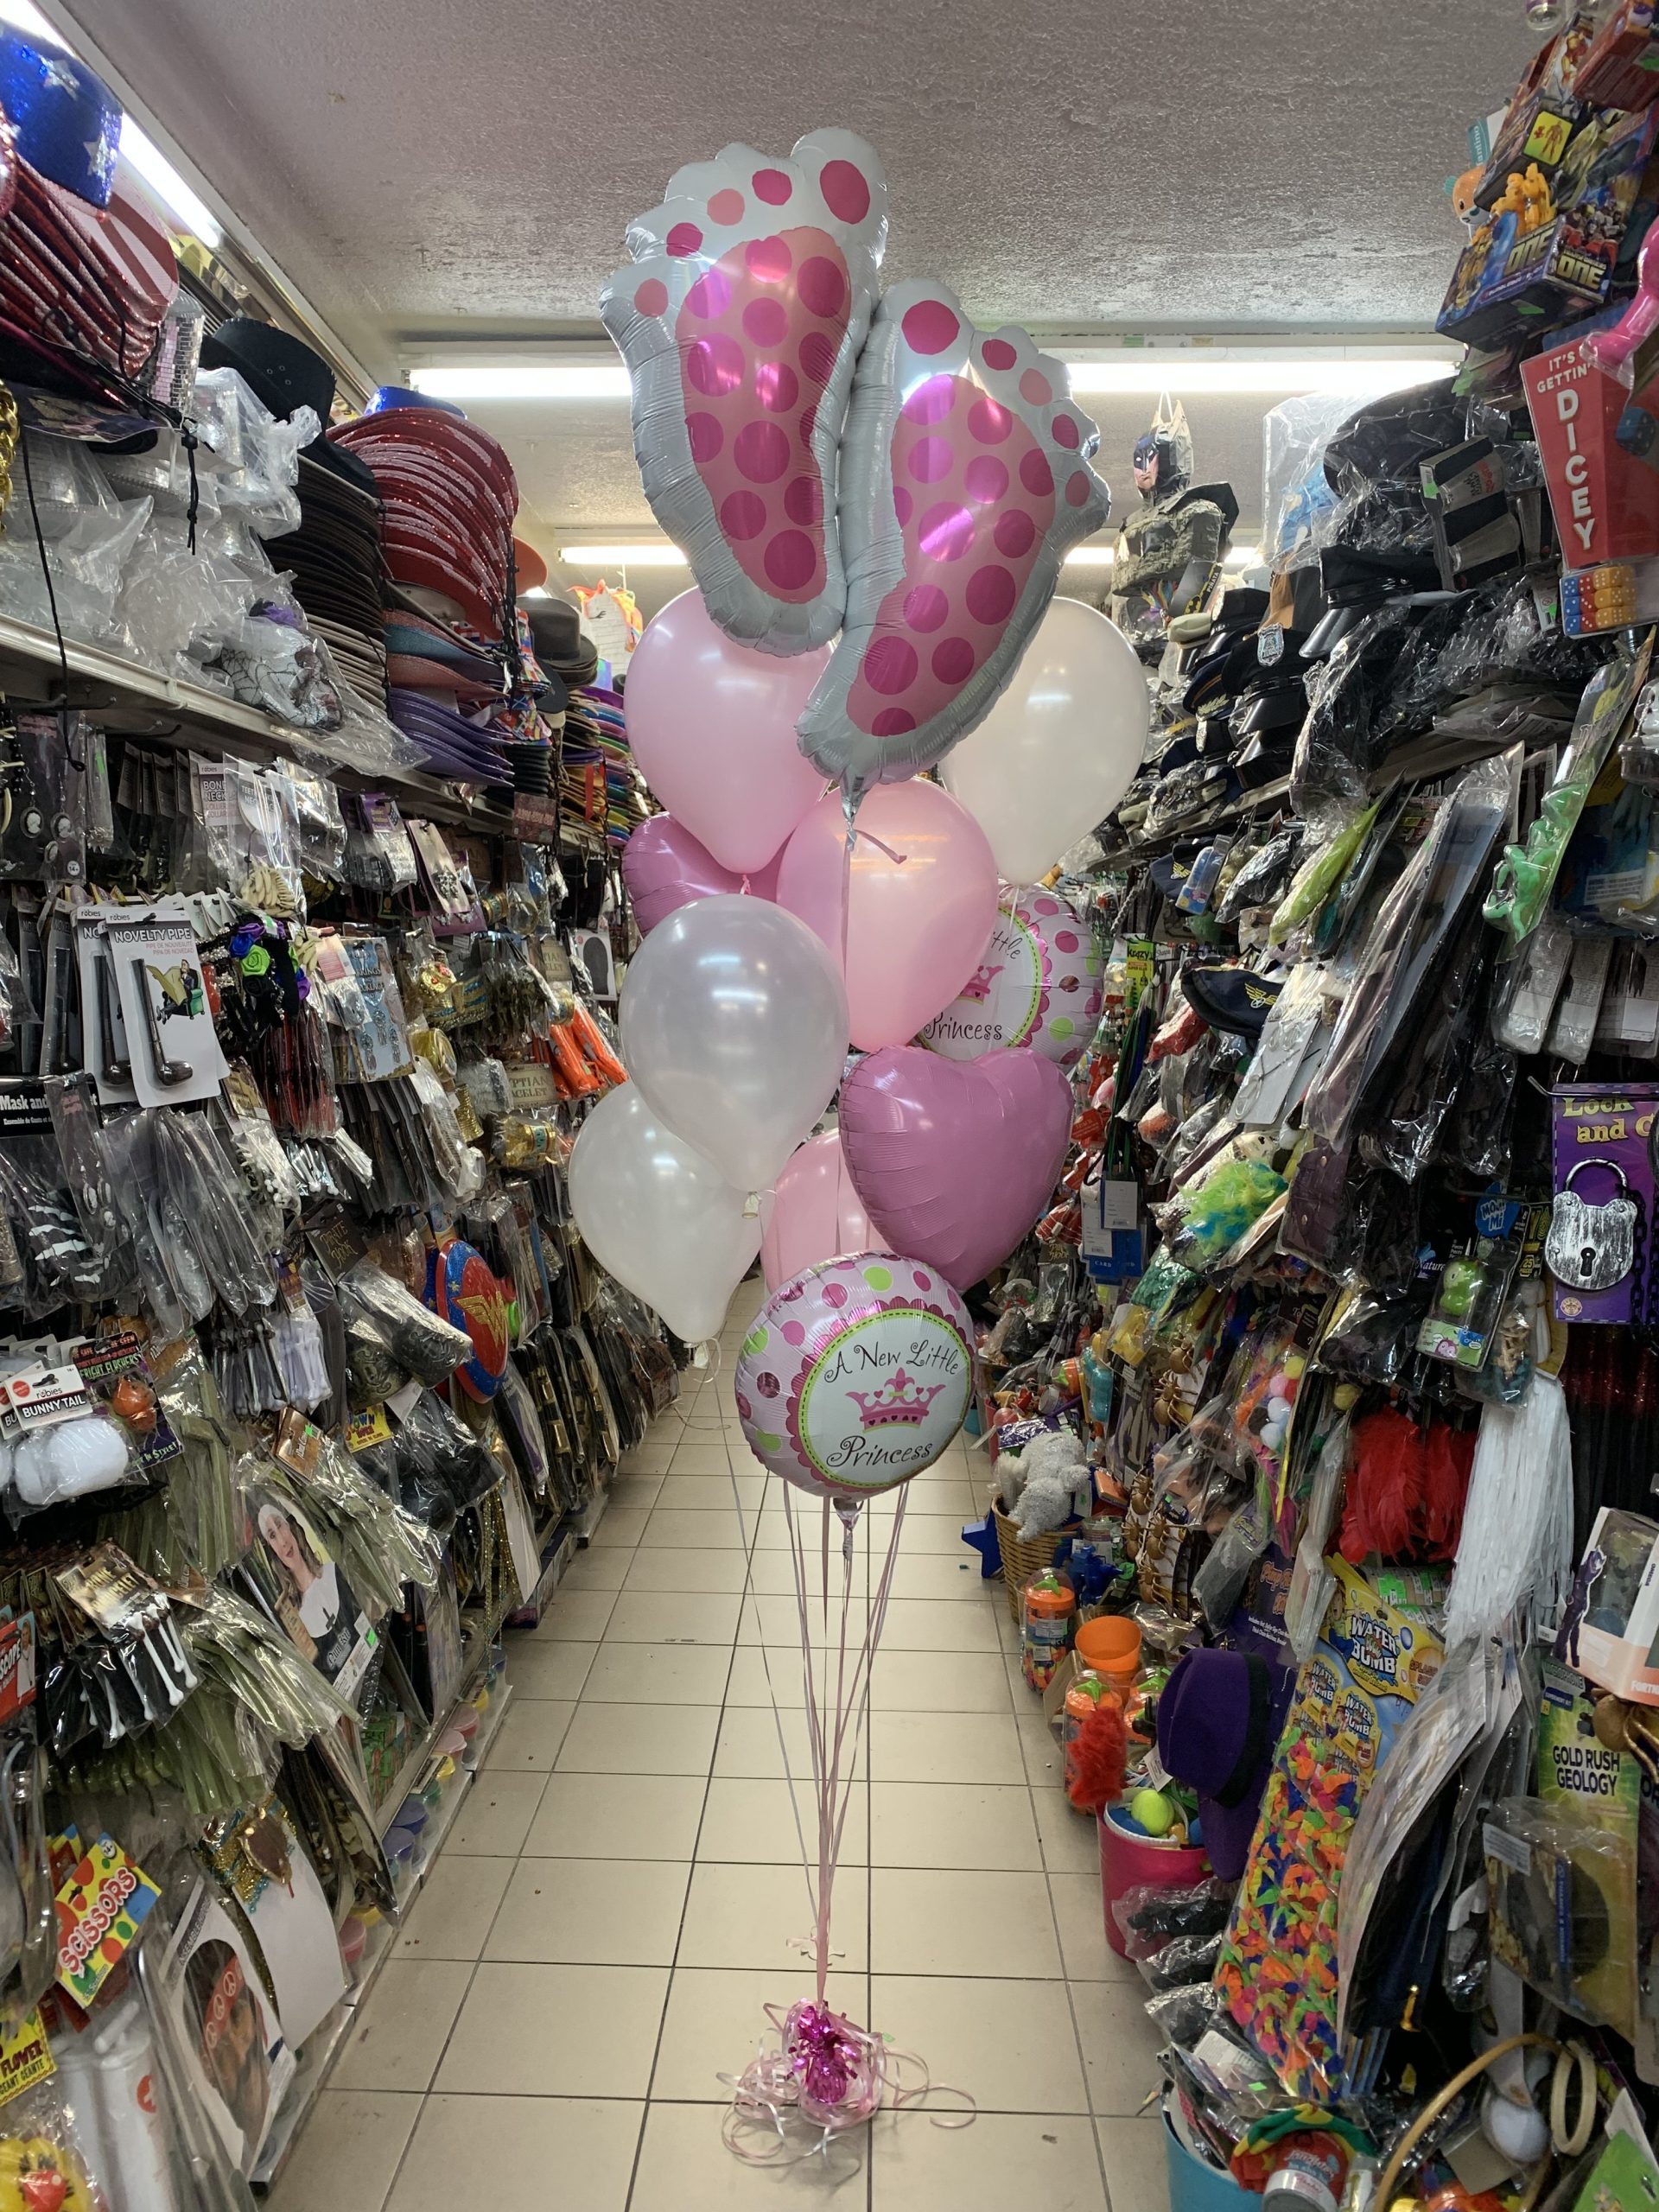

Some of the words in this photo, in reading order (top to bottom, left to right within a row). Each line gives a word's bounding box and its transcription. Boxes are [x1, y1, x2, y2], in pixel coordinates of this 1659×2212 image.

[1505, 227, 1554, 273] ONE
[1557, 252, 1607, 289] ONE
[1548, 351, 1576, 372] IT'S
[1536, 363, 1592, 393] GETTIN'
[1557, 389, 1595, 550] DICEY
[114, 929, 166, 944] NOVELTY
[167, 927, 192, 940] PIPE
[991, 930, 1023, 960] ttle
[923, 1011, 1002, 1040] Princess
[0, 1094, 29, 1111] Mask
[1576, 1117, 1629, 1144] and
[823, 1351, 853, 1383] A
[853, 1341, 901, 1371] New
[906, 1339, 959, 1376] Little
[22, 1400, 61, 1419] BUNNY
[61, 1395, 86, 1408] TAIL
[826, 1434, 933, 1468] Princess
[1351, 1615, 1398, 1657] WATER
[1313, 1662, 1337, 1691] WATER
[1345, 1695, 1373, 1725] WATER
[1553, 1745, 1583, 1768] GOLD
[1586, 1748, 1620, 1772] RUSH
[1557, 1767, 1618, 1796] GEOLOGY
[59, 1866, 137, 1979] SCISSORS
